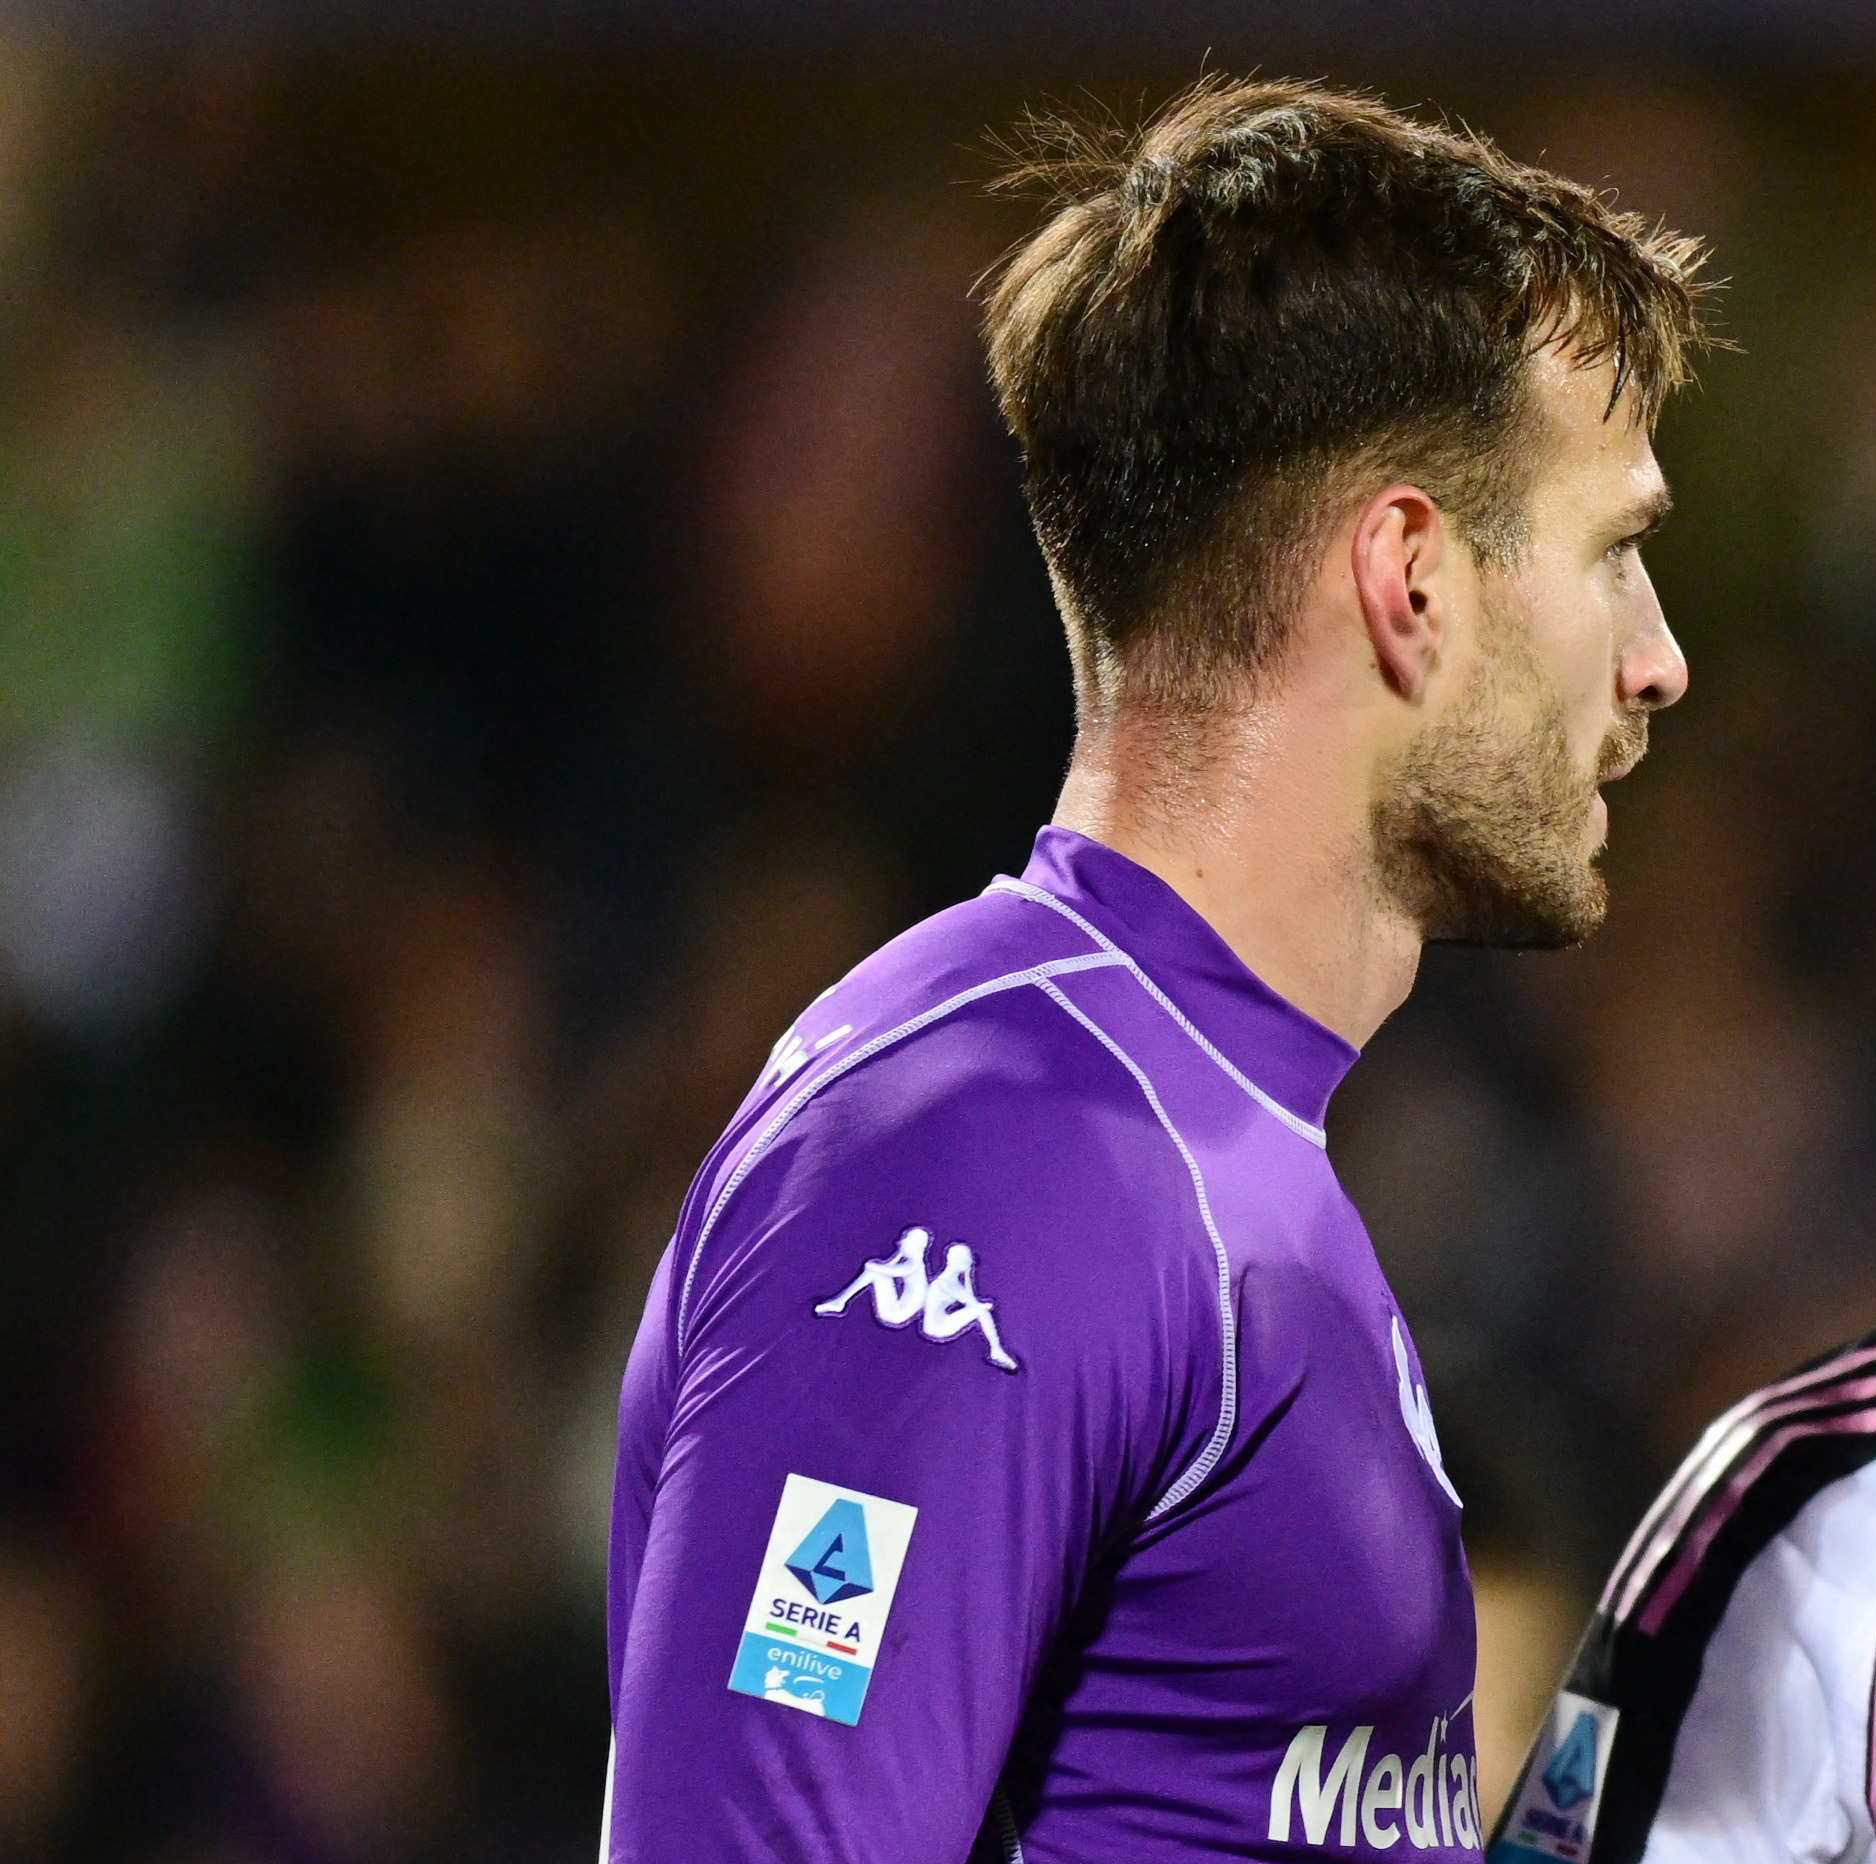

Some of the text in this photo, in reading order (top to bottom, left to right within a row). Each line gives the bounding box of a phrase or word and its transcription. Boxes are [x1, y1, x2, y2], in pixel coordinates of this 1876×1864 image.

[769, 1598, 861, 1643] SERIE A
[767, 1647, 842, 1680] enilive
[1268, 1710, 1484, 1850] Media
